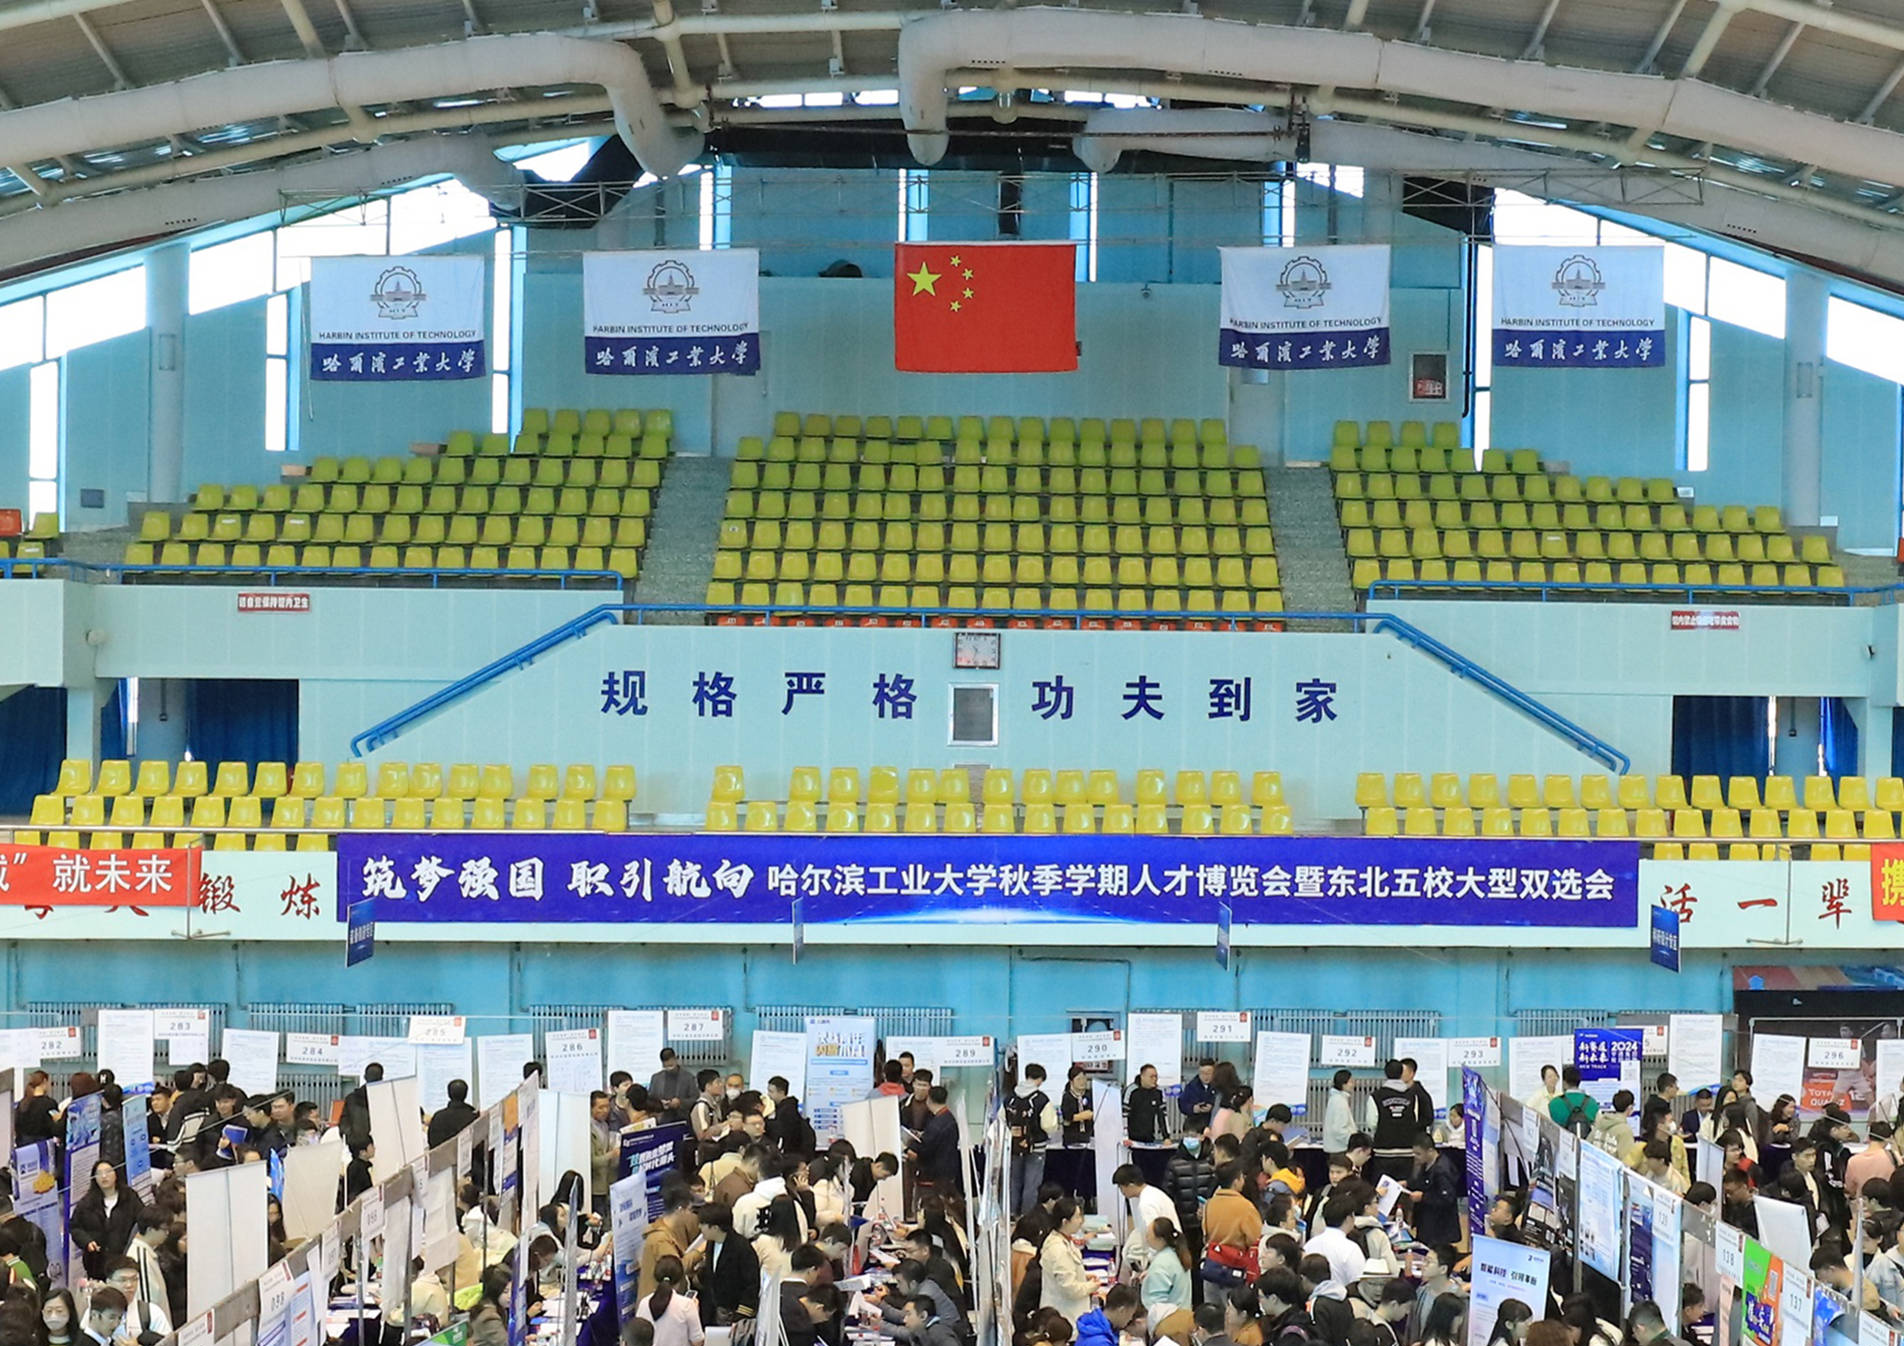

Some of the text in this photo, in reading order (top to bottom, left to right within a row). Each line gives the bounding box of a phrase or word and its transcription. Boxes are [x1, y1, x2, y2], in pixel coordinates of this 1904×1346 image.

[1230, 316, 1382, 329] HARBIN INSTITUTE OF TECHNOLOGY
[1501, 317, 1655, 327] HARBIN INSTITUTE OF TECHNOLOGY
[593, 321, 748, 334] HARBIN INSTITUTE OF TECHNOLOGY
[319, 329, 477, 341] HARBIN INSTITUTE OF TECHNOLOGY
[601, 669, 1337, 725] 规格严格 功夫到家
[52, 853, 173, 896] 就未来
[362, 855, 1616, 902] 筑梦强国 职引航向 哈尔滨工业大学秋季学期人才博览会暨东北五校大型双选会
[170, 1022, 191, 1031] 283
[683, 1023, 704, 1032] 287
[1212, 1024, 1232, 1033] 291
[41, 1040, 63, 1050] 282
[562, 1043, 583, 1053] 286
[1087, 1044, 1108, 1054] 290
[1611, 1041, 1639, 1052] 2024
[302, 1046, 323, 1056] 284
[955, 1048, 976, 1058] 289
[1337, 1048, 1358, 1057] 292
[1463, 1050, 1484, 1059] 293
[1824, 1051, 1844, 1060] 296
